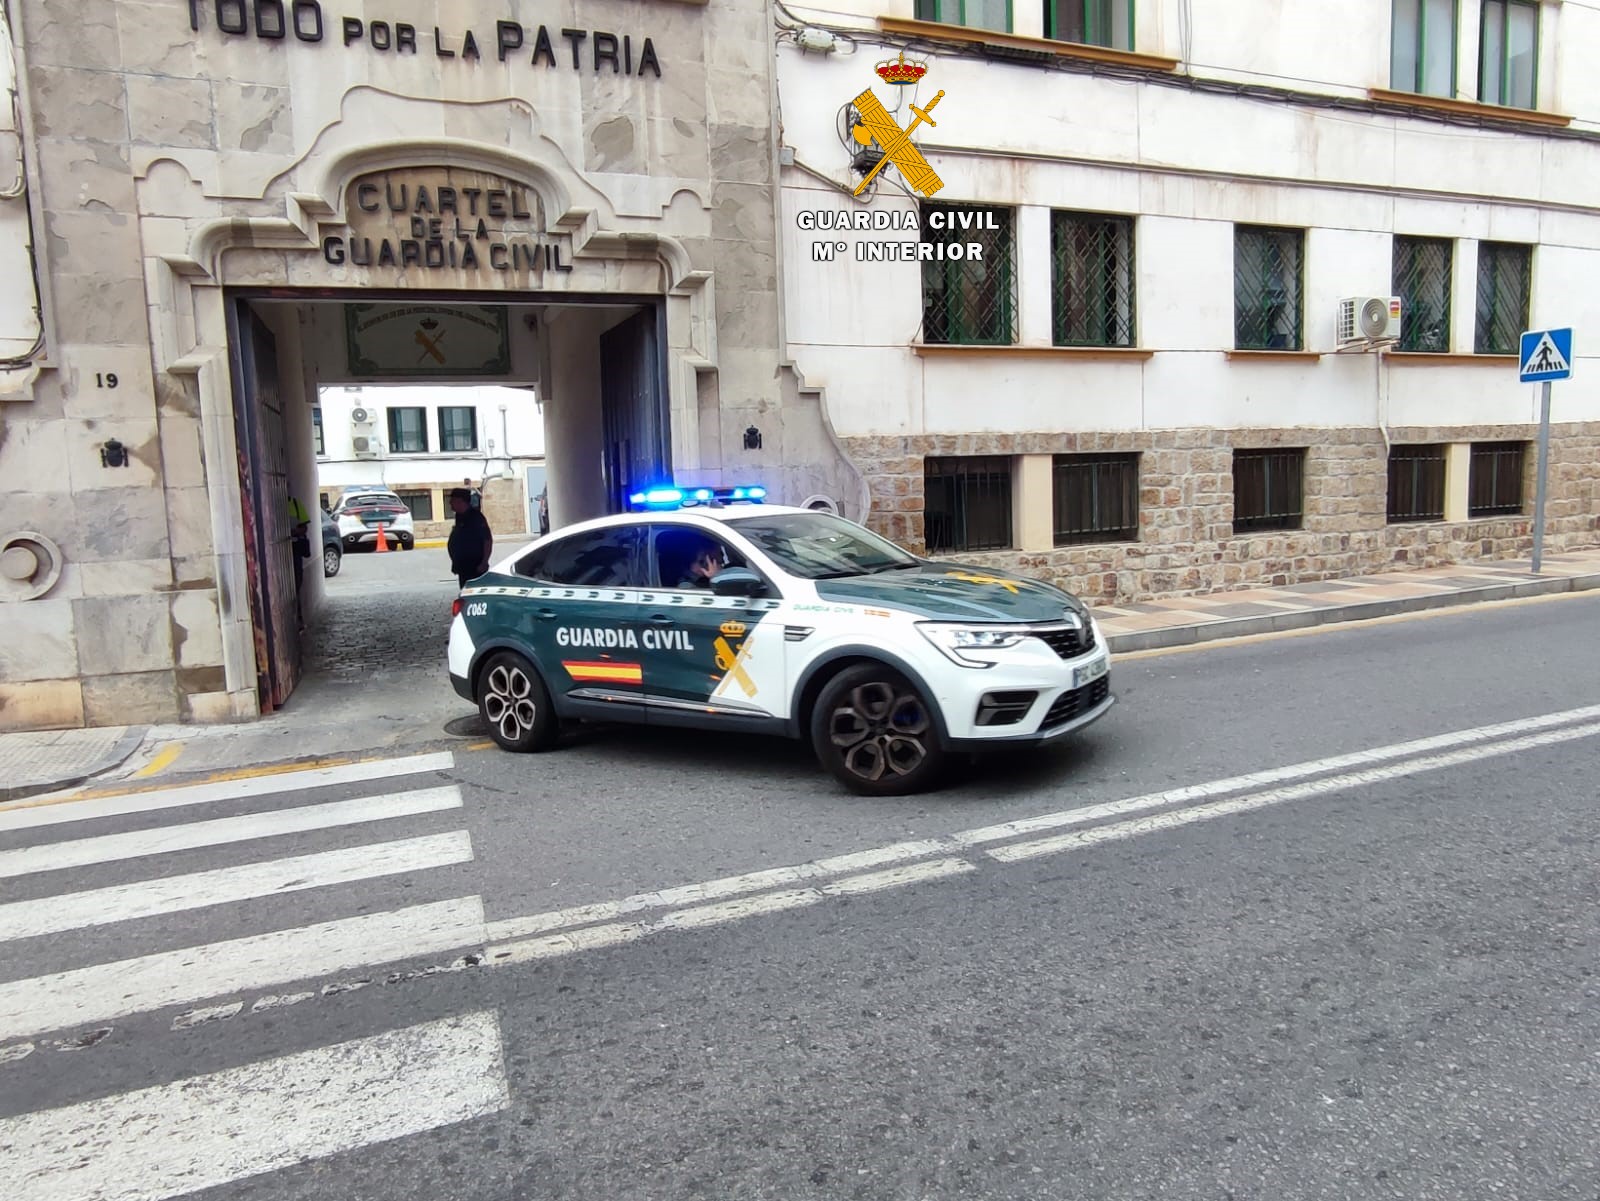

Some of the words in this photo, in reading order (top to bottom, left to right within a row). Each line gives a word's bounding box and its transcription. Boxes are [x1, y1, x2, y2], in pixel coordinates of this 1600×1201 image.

[342, 16, 416, 55] POR
[434, 26, 480, 61] LA
[496, 19, 661, 78] PATRIA
[357, 183, 530, 219] CUARTEL
[411, 215, 443, 241] DE
[455, 217, 489, 240] LA
[323, 235, 478, 270] GUARDIA
[490, 242, 573, 272] CIVIL
[96, 373, 119, 389] 19
[556, 627, 639, 649] GUARDIA
[642, 629, 695, 651] CIVIL
